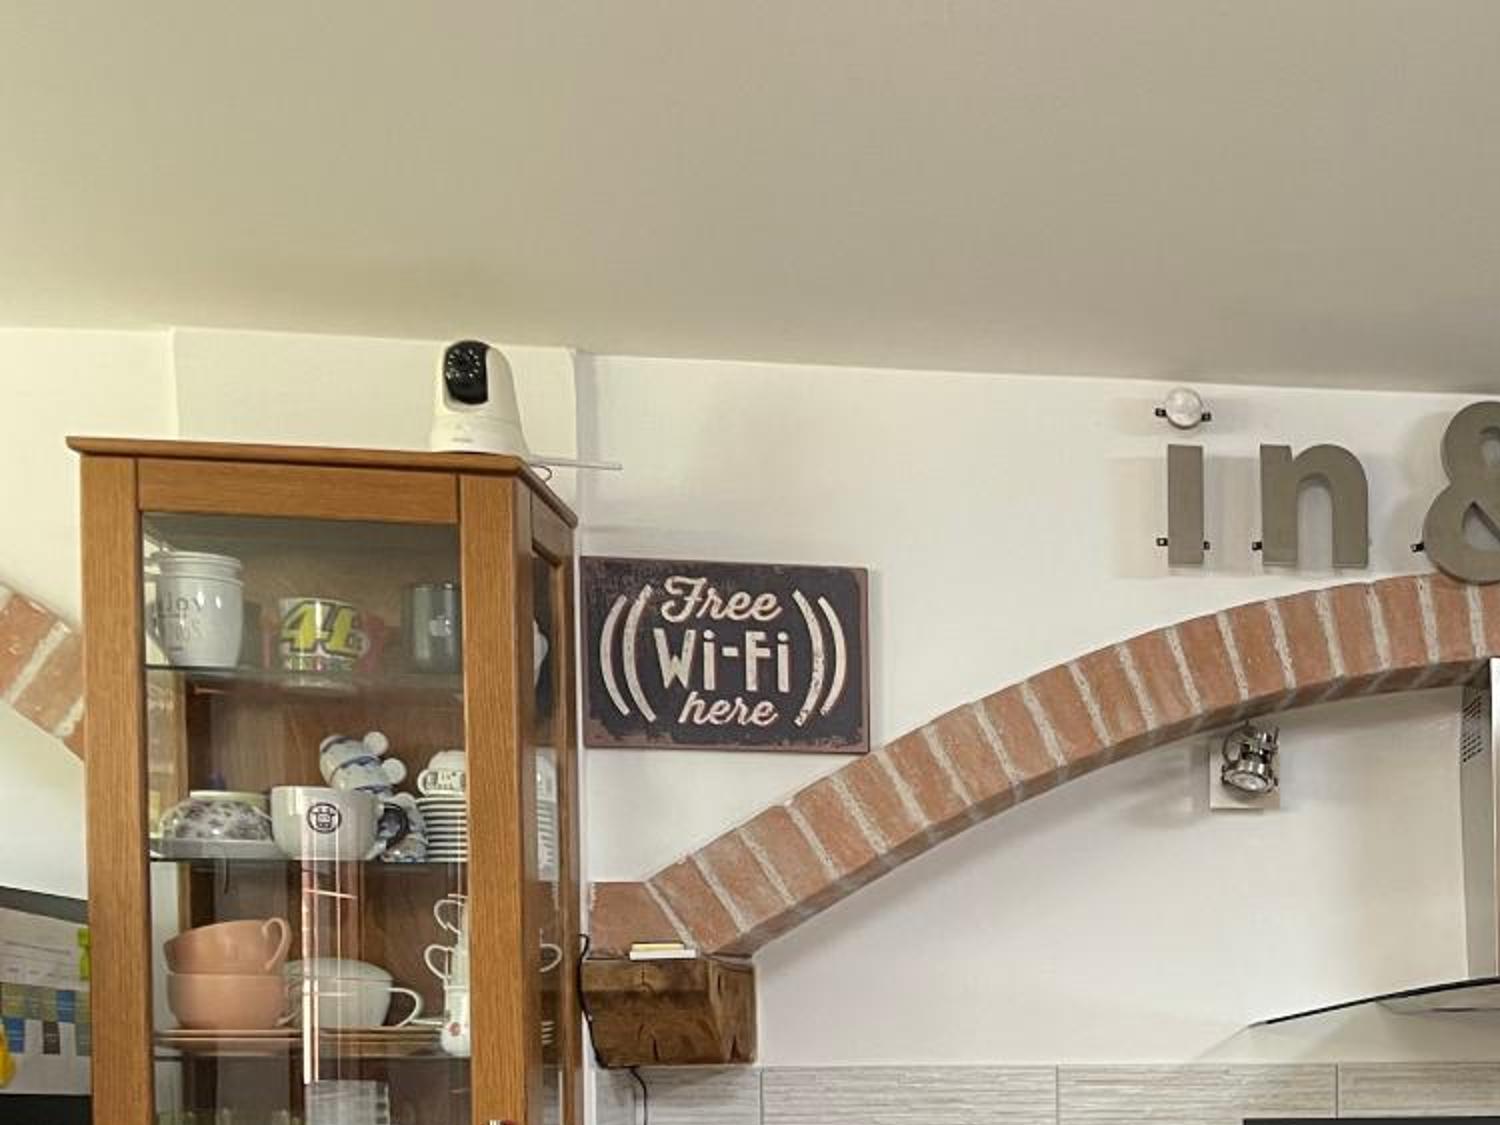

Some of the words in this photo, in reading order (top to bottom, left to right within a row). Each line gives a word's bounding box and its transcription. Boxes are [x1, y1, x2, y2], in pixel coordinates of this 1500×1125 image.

[660, 575, 783, 623] Free
[653, 628, 790, 693] Wi-Fi
[677, 691, 779, 726] here
